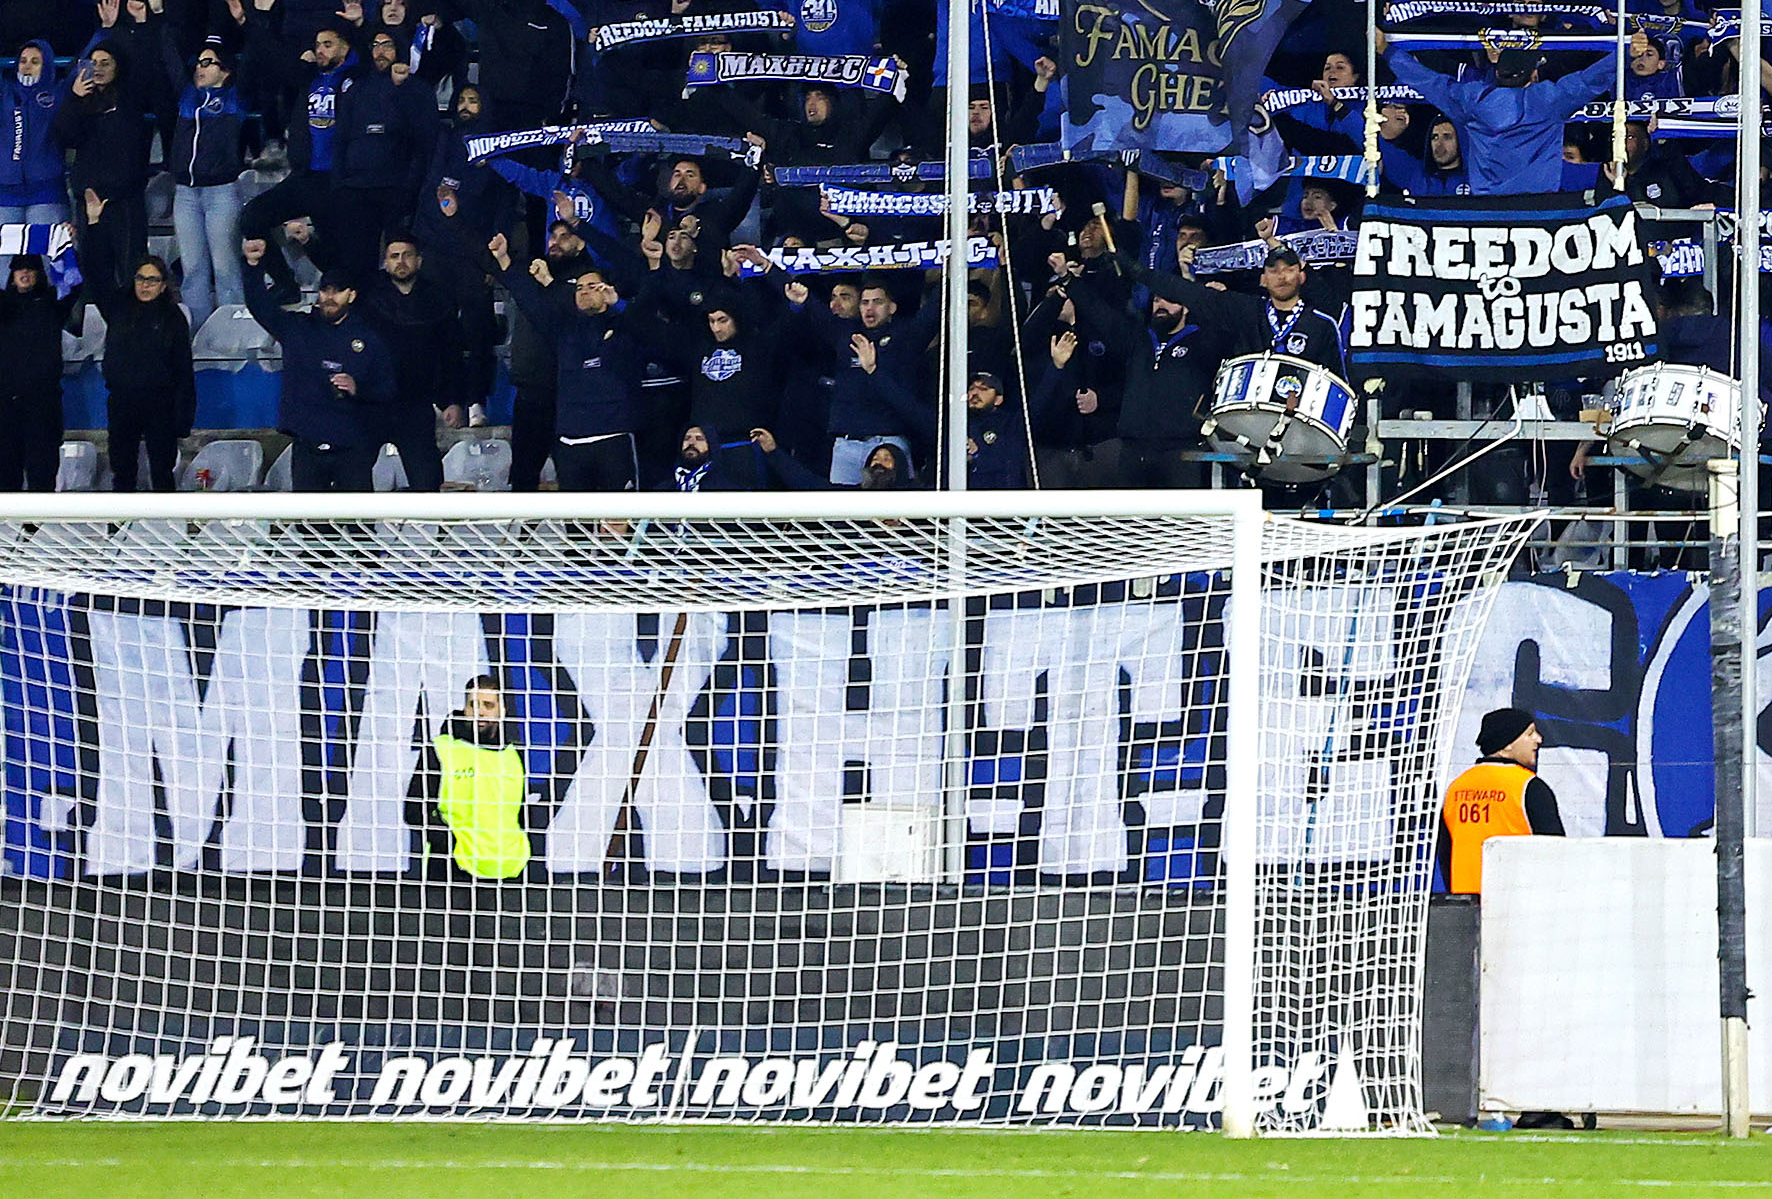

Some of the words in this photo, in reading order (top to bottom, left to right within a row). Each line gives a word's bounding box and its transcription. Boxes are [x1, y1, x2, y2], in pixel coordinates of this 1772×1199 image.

[1352, 213, 1644, 281] FREEDOM
[1476, 272, 1522, 301] to
[1349, 280, 1656, 350] FAMAGUSTA
[1604, 343, 1645, 363] 1911
[1459, 803, 1490, 823] 061
[52, 1034, 345, 1104] novibet
[370, 1037, 671, 1108] novibet
[691, 1040, 993, 1111] novibet
